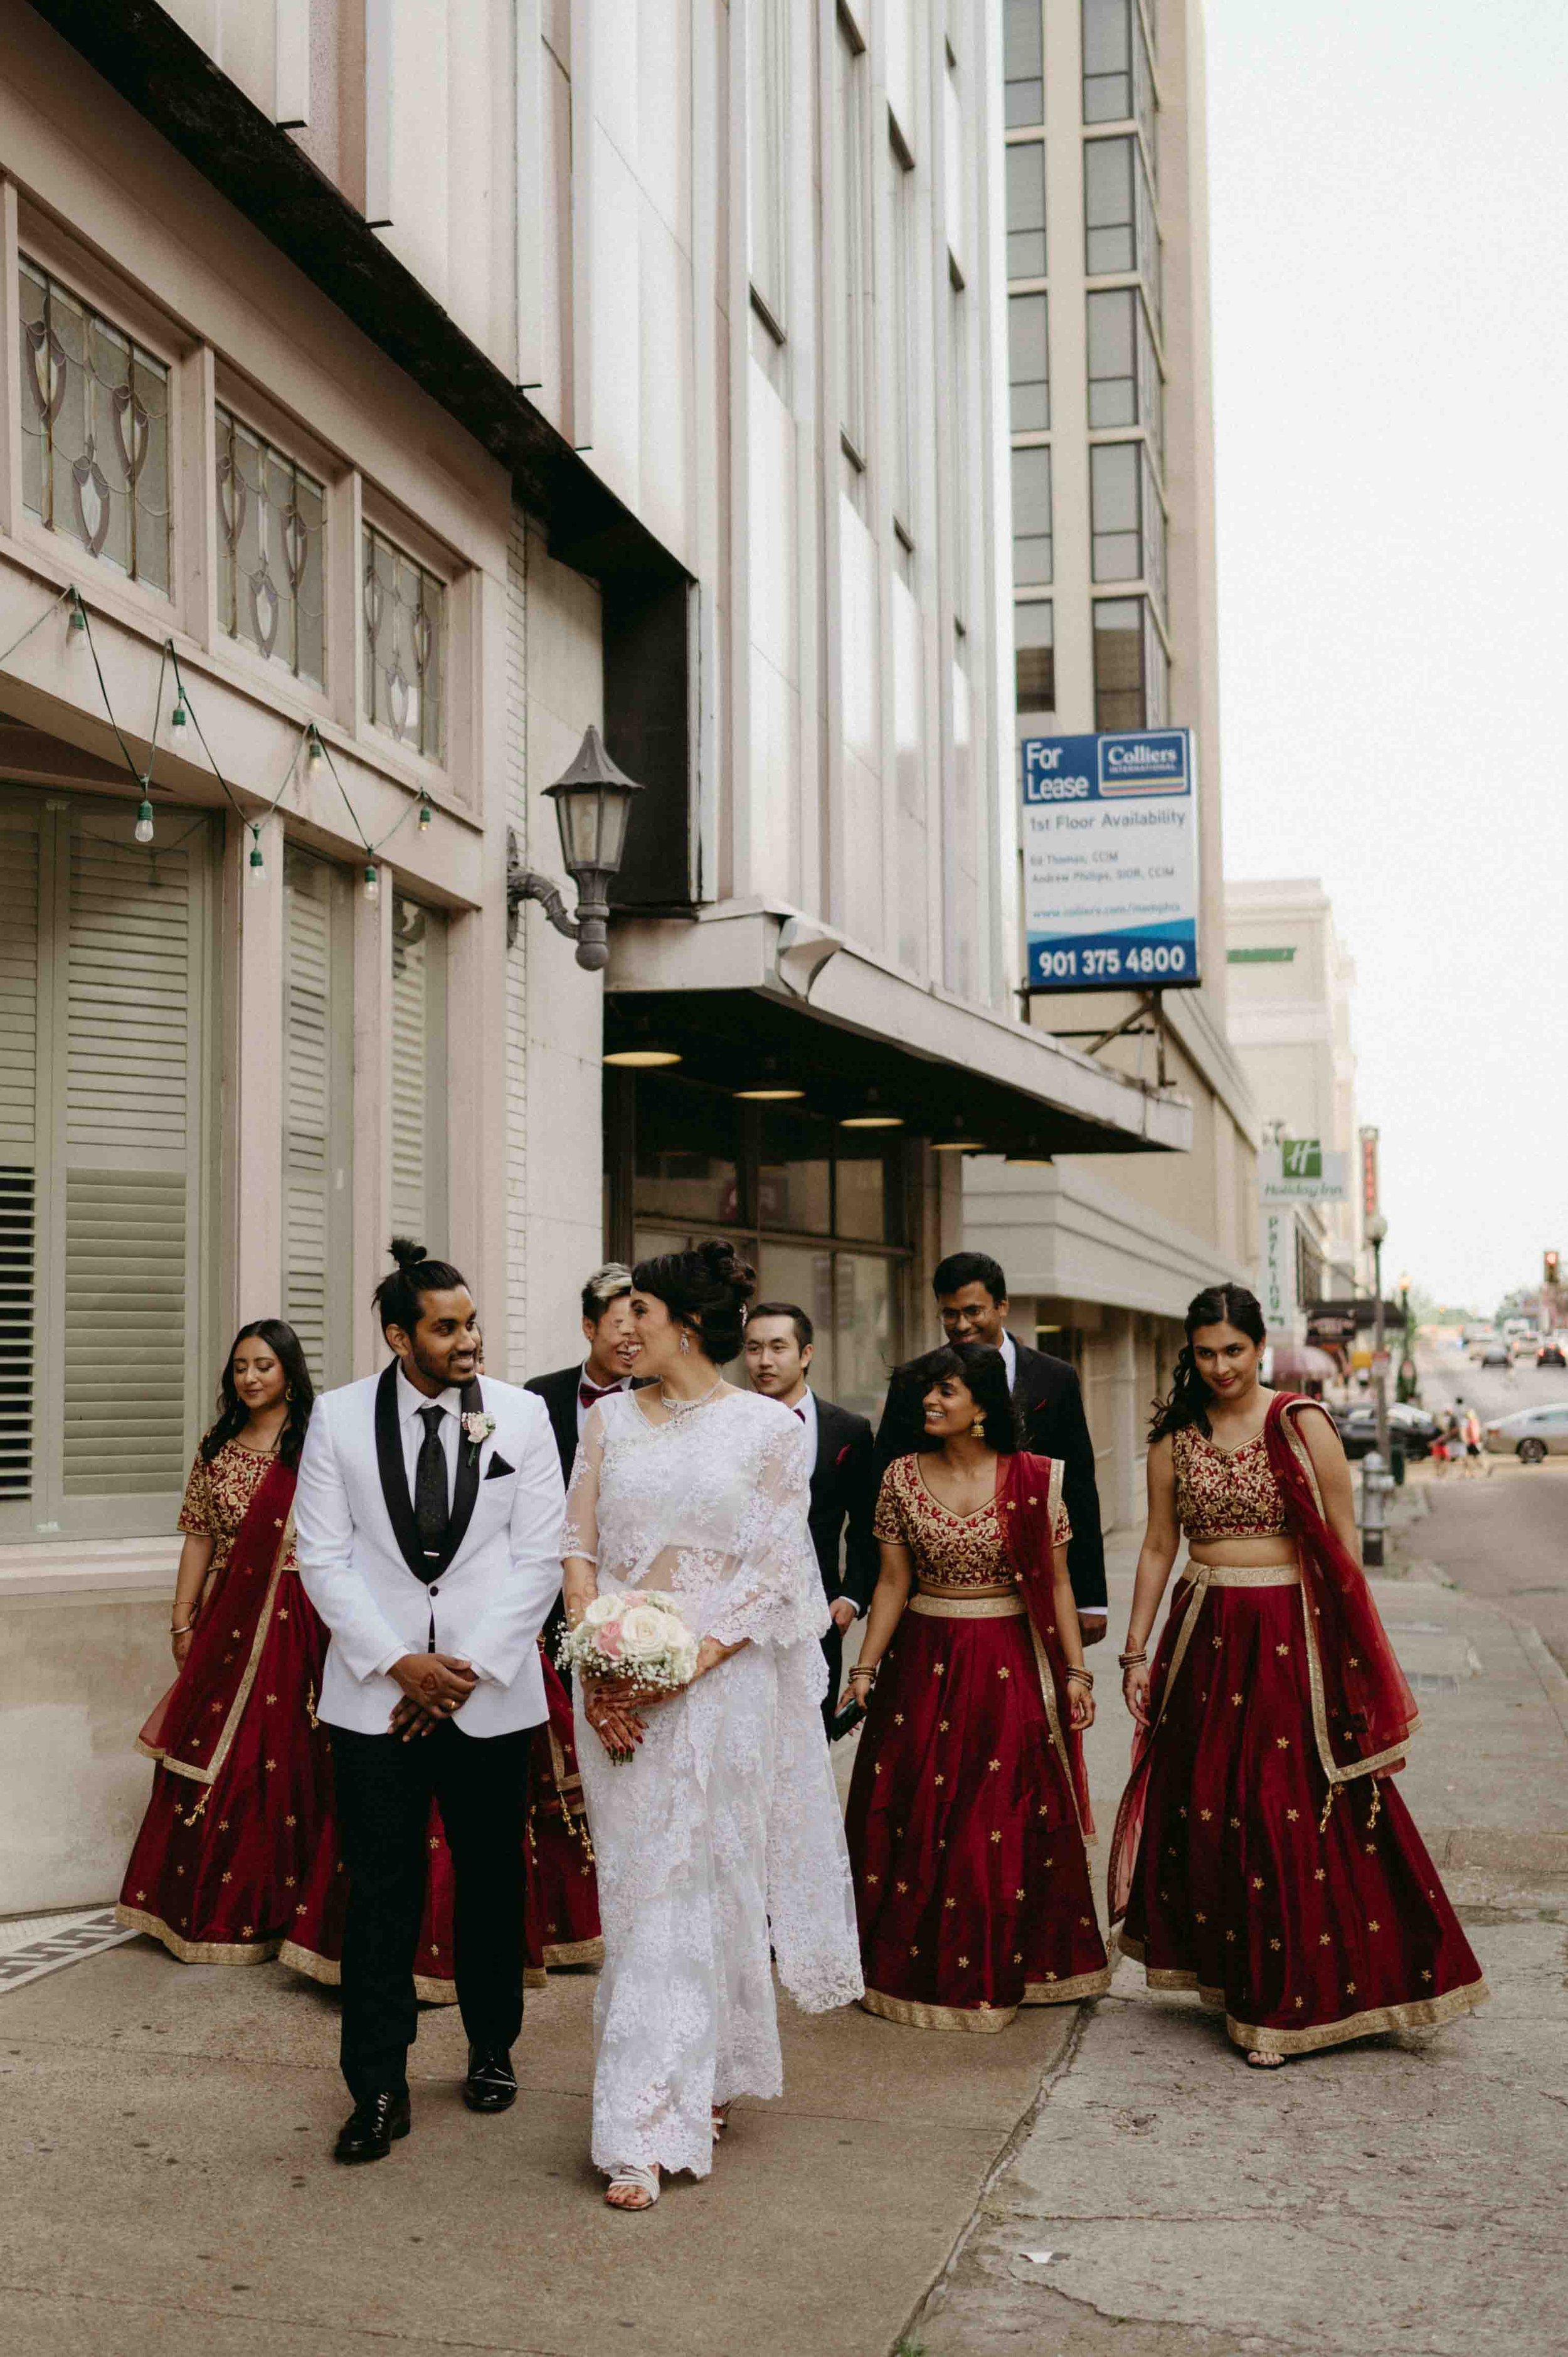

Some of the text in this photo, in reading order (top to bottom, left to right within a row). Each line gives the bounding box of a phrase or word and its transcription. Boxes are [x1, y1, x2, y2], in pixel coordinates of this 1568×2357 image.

[1026, 741, 1063, 770] For
[1107, 744, 1178, 765] Colliers
[1027, 773, 1089, 801] Lease
[1030, 808, 1186, 832] 1st Floor Availability
[1039, 945, 1186, 978] 901 375 4800
